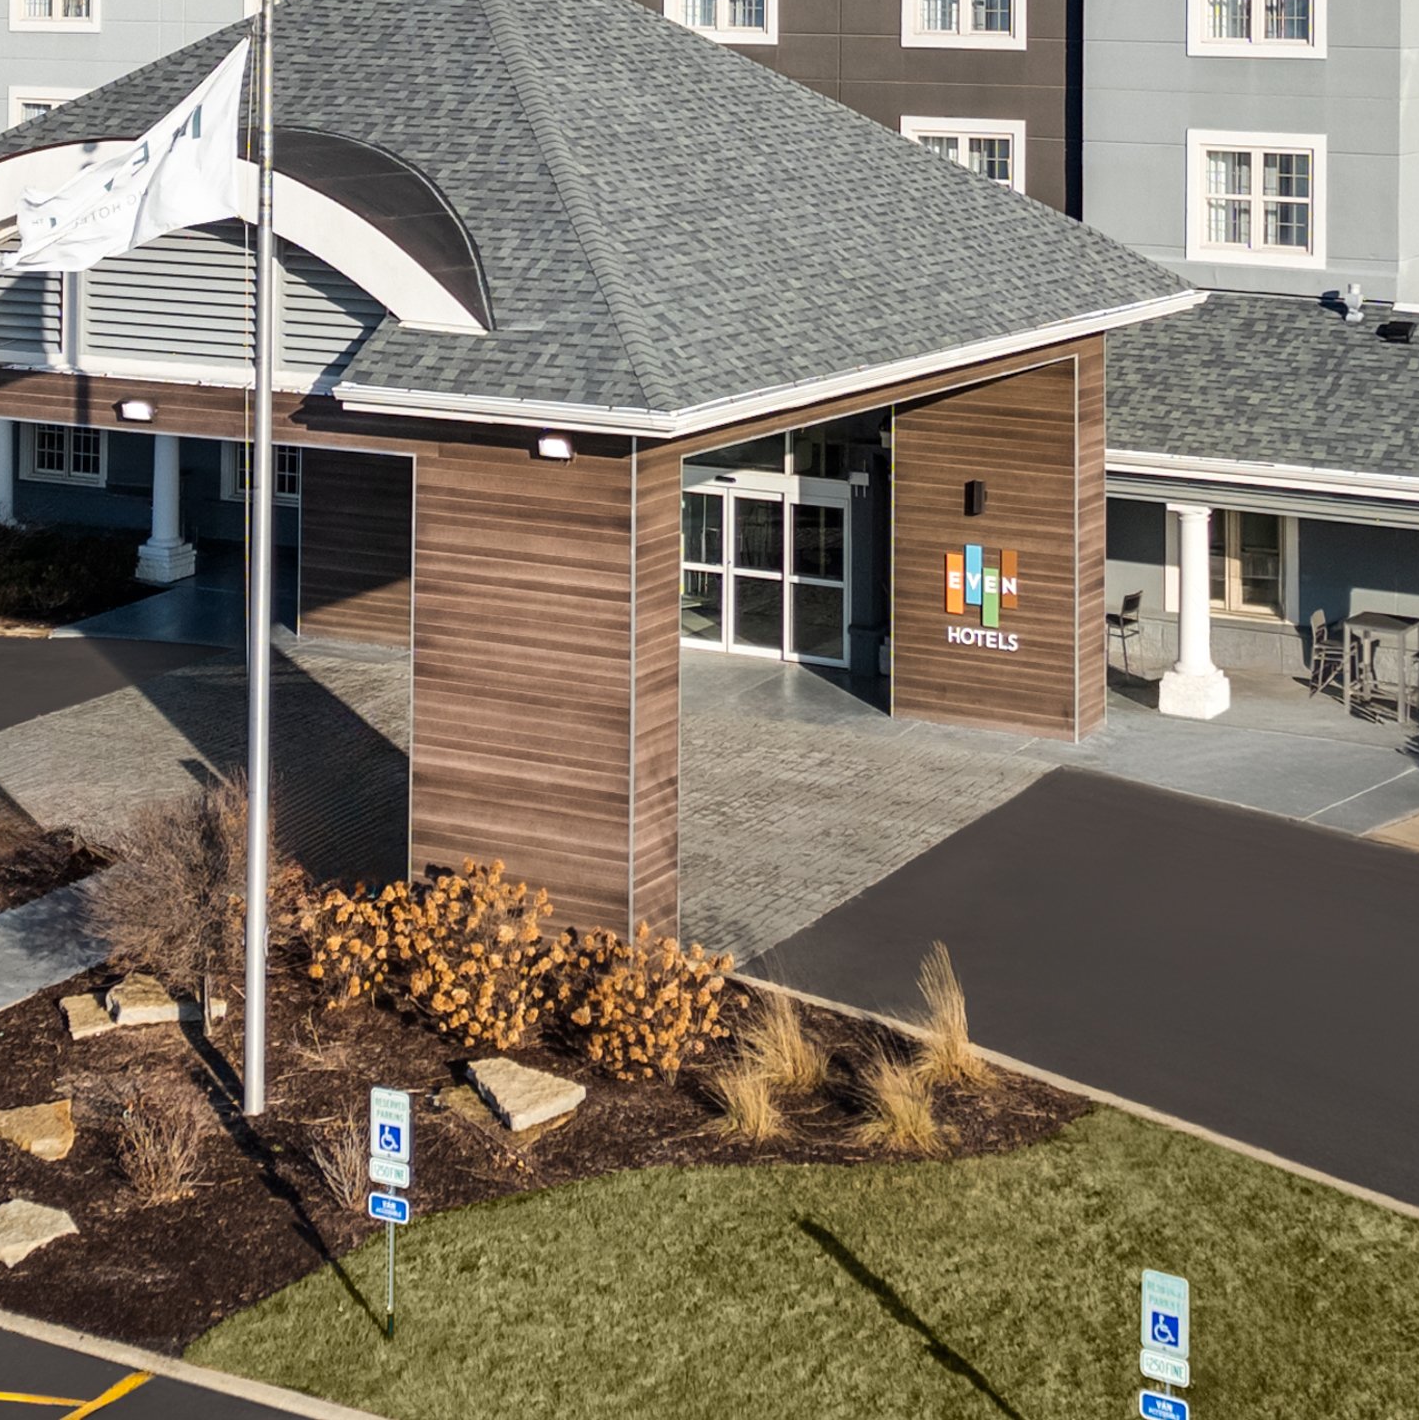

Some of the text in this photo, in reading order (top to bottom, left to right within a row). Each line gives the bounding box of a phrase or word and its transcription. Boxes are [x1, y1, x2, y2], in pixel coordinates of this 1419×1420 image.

[948, 571, 1017, 595] EVEN
[947, 626, 1019, 652] HOTELS
[1155, 1399, 1174, 1412] VAN
